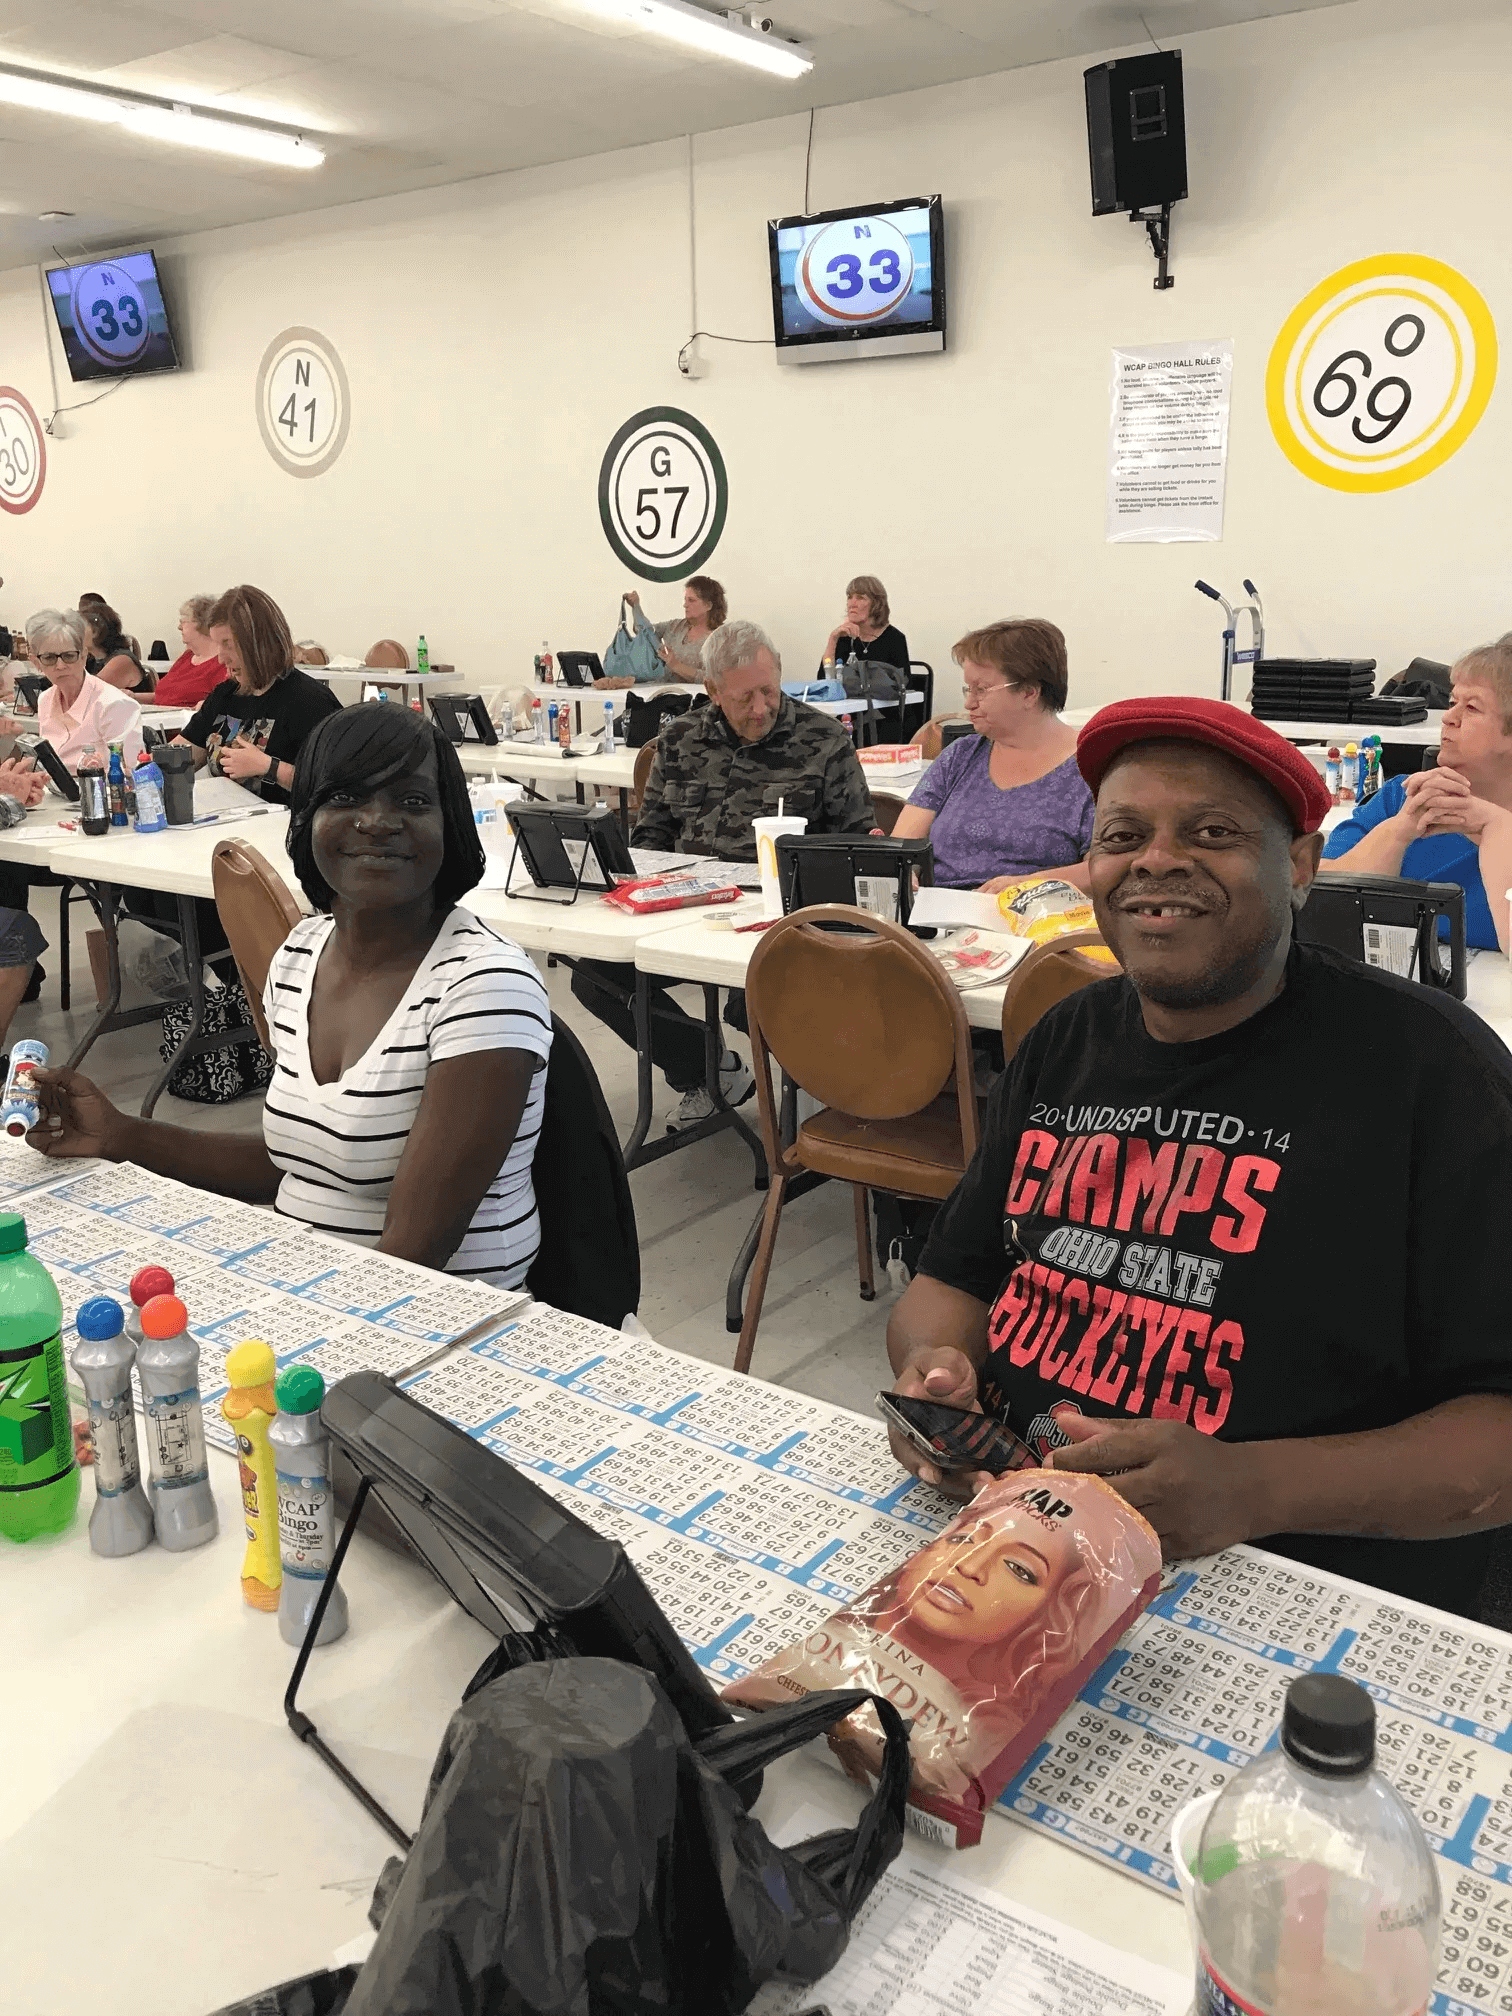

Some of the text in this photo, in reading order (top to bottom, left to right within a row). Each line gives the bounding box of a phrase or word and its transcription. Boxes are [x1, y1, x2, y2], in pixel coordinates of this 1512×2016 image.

[854, 225, 871, 239] N
[101, 271, 115, 286] N
[826, 249, 901, 299] 33
[91, 295, 143, 341] 33
[1384, 313, 1425, 358] O
[295, 358, 310, 387] N
[1123, 363, 1146, 372] WCAP
[1173, 360, 1194, 368] HALL
[1194, 357, 1221, 366] RULES
[278, 392, 316, 443] 41
[1313, 350, 1412, 444] 69
[0, 437, 30, 486] 30
[650, 446, 671, 478] G
[636, 486, 689, 540] 57
[1005, 1129, 1282, 1255] CHAMPS
[1038, 1225, 1224, 1308] OHIO STATE
[987, 1259, 1245, 1436] BUCKEYES
[490, 1426, 510, 1436] 70
[505, 1417, 577, 1449] 25 45 55 63
[507, 1433, 526, 1444] 50
[526, 1440, 544, 1450] 34
[544, 1449, 563, 1458] 19
[725, 1493, 829, 1539] 9 26 58 63
[739, 1484, 846, 1530] 10 17 39 59 68
[753, 1474, 859, 1519] 13 30 37 47 71
[698, 1513, 803, 1560] 1 25 38 52 73
[712, 1503, 817, 1549] 3 27 33 46 62
[1368, 1620, 1492, 1670] 24 44 49 62
[1376, 1608, 1498, 1658] 30 35 58 65
[1354, 1644, 1510, 1710] 14 29 32 52 61
[1360, 1632, 1485, 1684] 27 59 74
[1341, 1658, 1497, 1720] 3 18 40 55 66
[1065, 1730, 1188, 1792] 28 32 59 69
[1078, 1716, 1200, 1775] 17 36 46 66
[1039, 1760, 1164, 1825] 19 41 54 62
[1055, 1746, 1177, 1808] 26 51 61
[1024, 1777, 1152, 1842] 18 43 58 75
